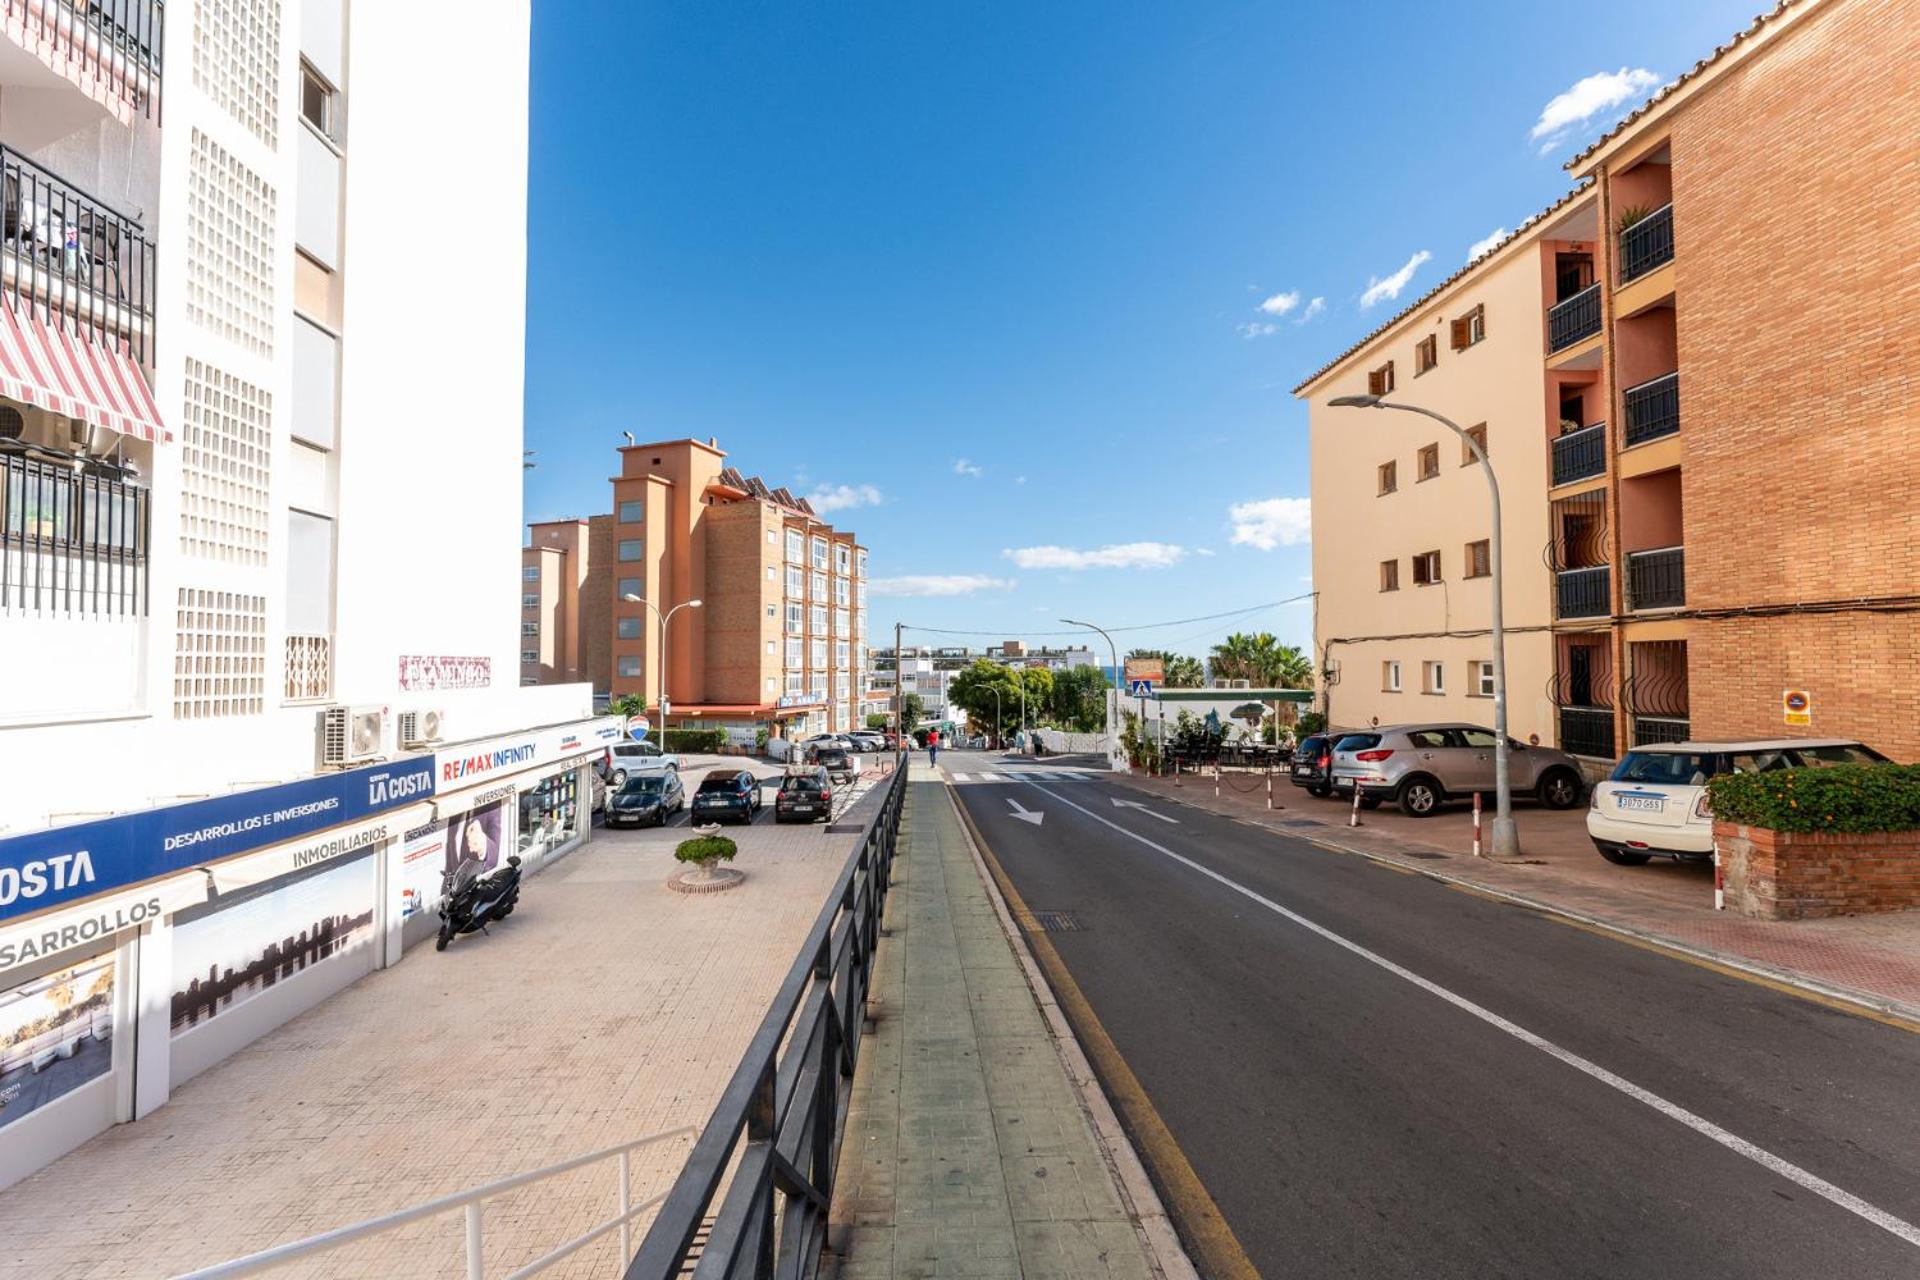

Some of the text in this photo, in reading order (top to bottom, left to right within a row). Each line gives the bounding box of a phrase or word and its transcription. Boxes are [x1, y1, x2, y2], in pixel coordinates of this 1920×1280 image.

[443, 743, 537, 782] RE/MAX INFINITY
[369, 771, 432, 805] LA COSTA
[473, 783, 516, 807] INVERSIONES
[164, 797, 339, 851] DESARROLLOS E INVERSIONES
[292, 825, 388, 868] INMOBILIARIOS
[0, 897, 162, 968] SARROLLOS
